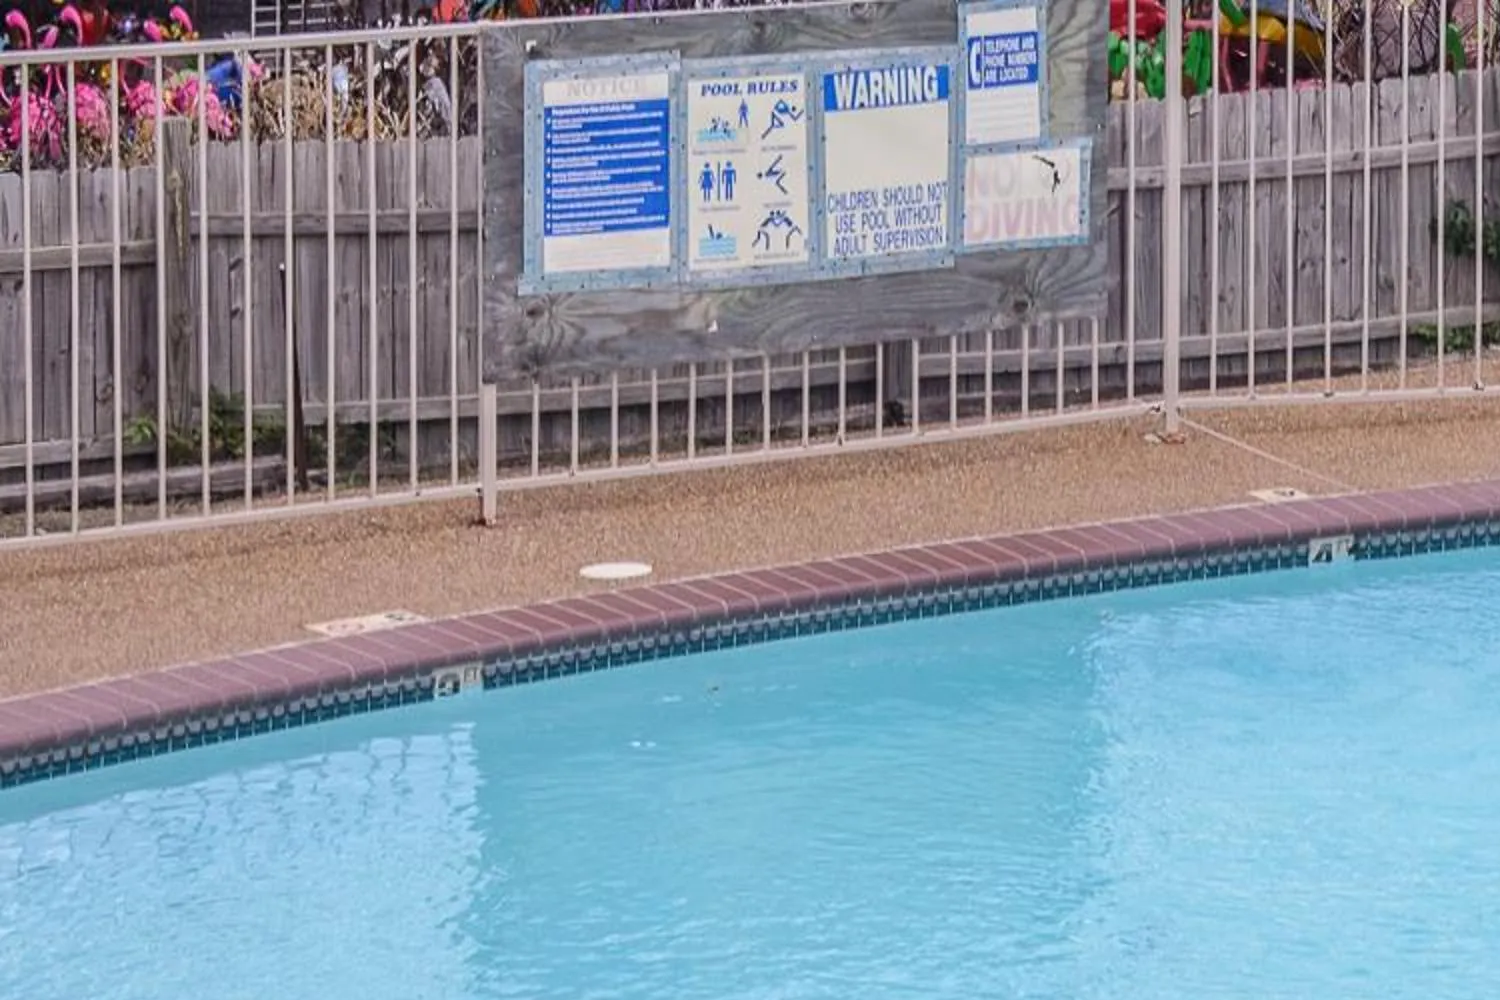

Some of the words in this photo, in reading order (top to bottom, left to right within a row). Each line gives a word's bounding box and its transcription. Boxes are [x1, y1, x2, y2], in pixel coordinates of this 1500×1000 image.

[702, 83, 742, 97] POOL
[747, 80, 798, 95] RULES
[834, 66, 938, 110] WARNING
[828, 191, 879, 214] CHILDREN
[883, 184, 923, 207] SHOULD
[927, 181, 948, 202] NOT
[836, 212, 857, 234] USE
[862, 209, 890, 231] POOL
[895, 203, 941, 227] WITHOUT
[835, 234, 867, 257] ADULT
[874, 226, 944, 253] SUPERVISION
